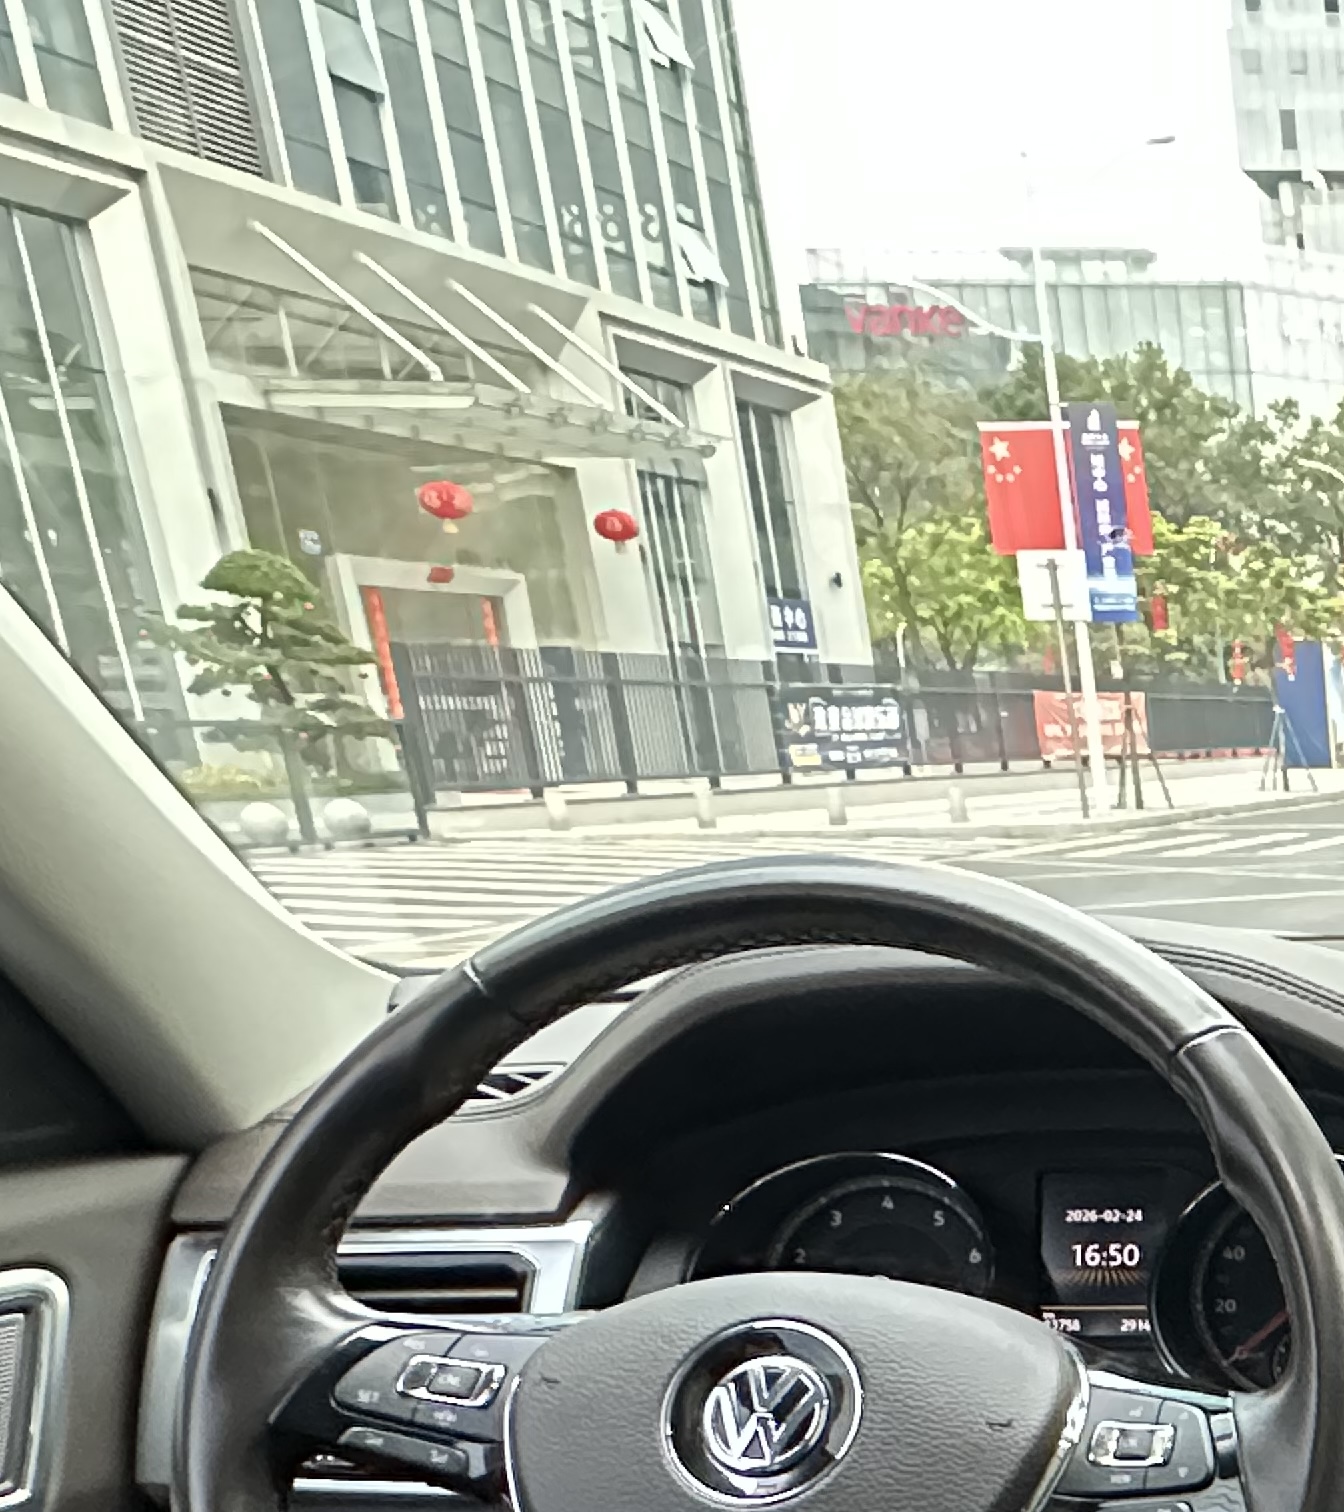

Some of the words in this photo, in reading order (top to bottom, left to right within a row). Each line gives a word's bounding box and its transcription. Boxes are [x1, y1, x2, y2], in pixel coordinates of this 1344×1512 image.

[844, 304, 965, 337] vanke
[881, 1194, 894, 1210] 4
[830, 1210, 843, 1227] 3
[933, 1210, 945, 1227] 5
[1065, 1208, 1144, 1223] 2026-02-24
[795, 1248, 806, 1264] 2
[969, 1247, 982, 1264] 6
[1071, 1243, 1140, 1267] 16:50
[1223, 1246, 1246, 1261] 40
[1214, 1299, 1237, 1314] 20
